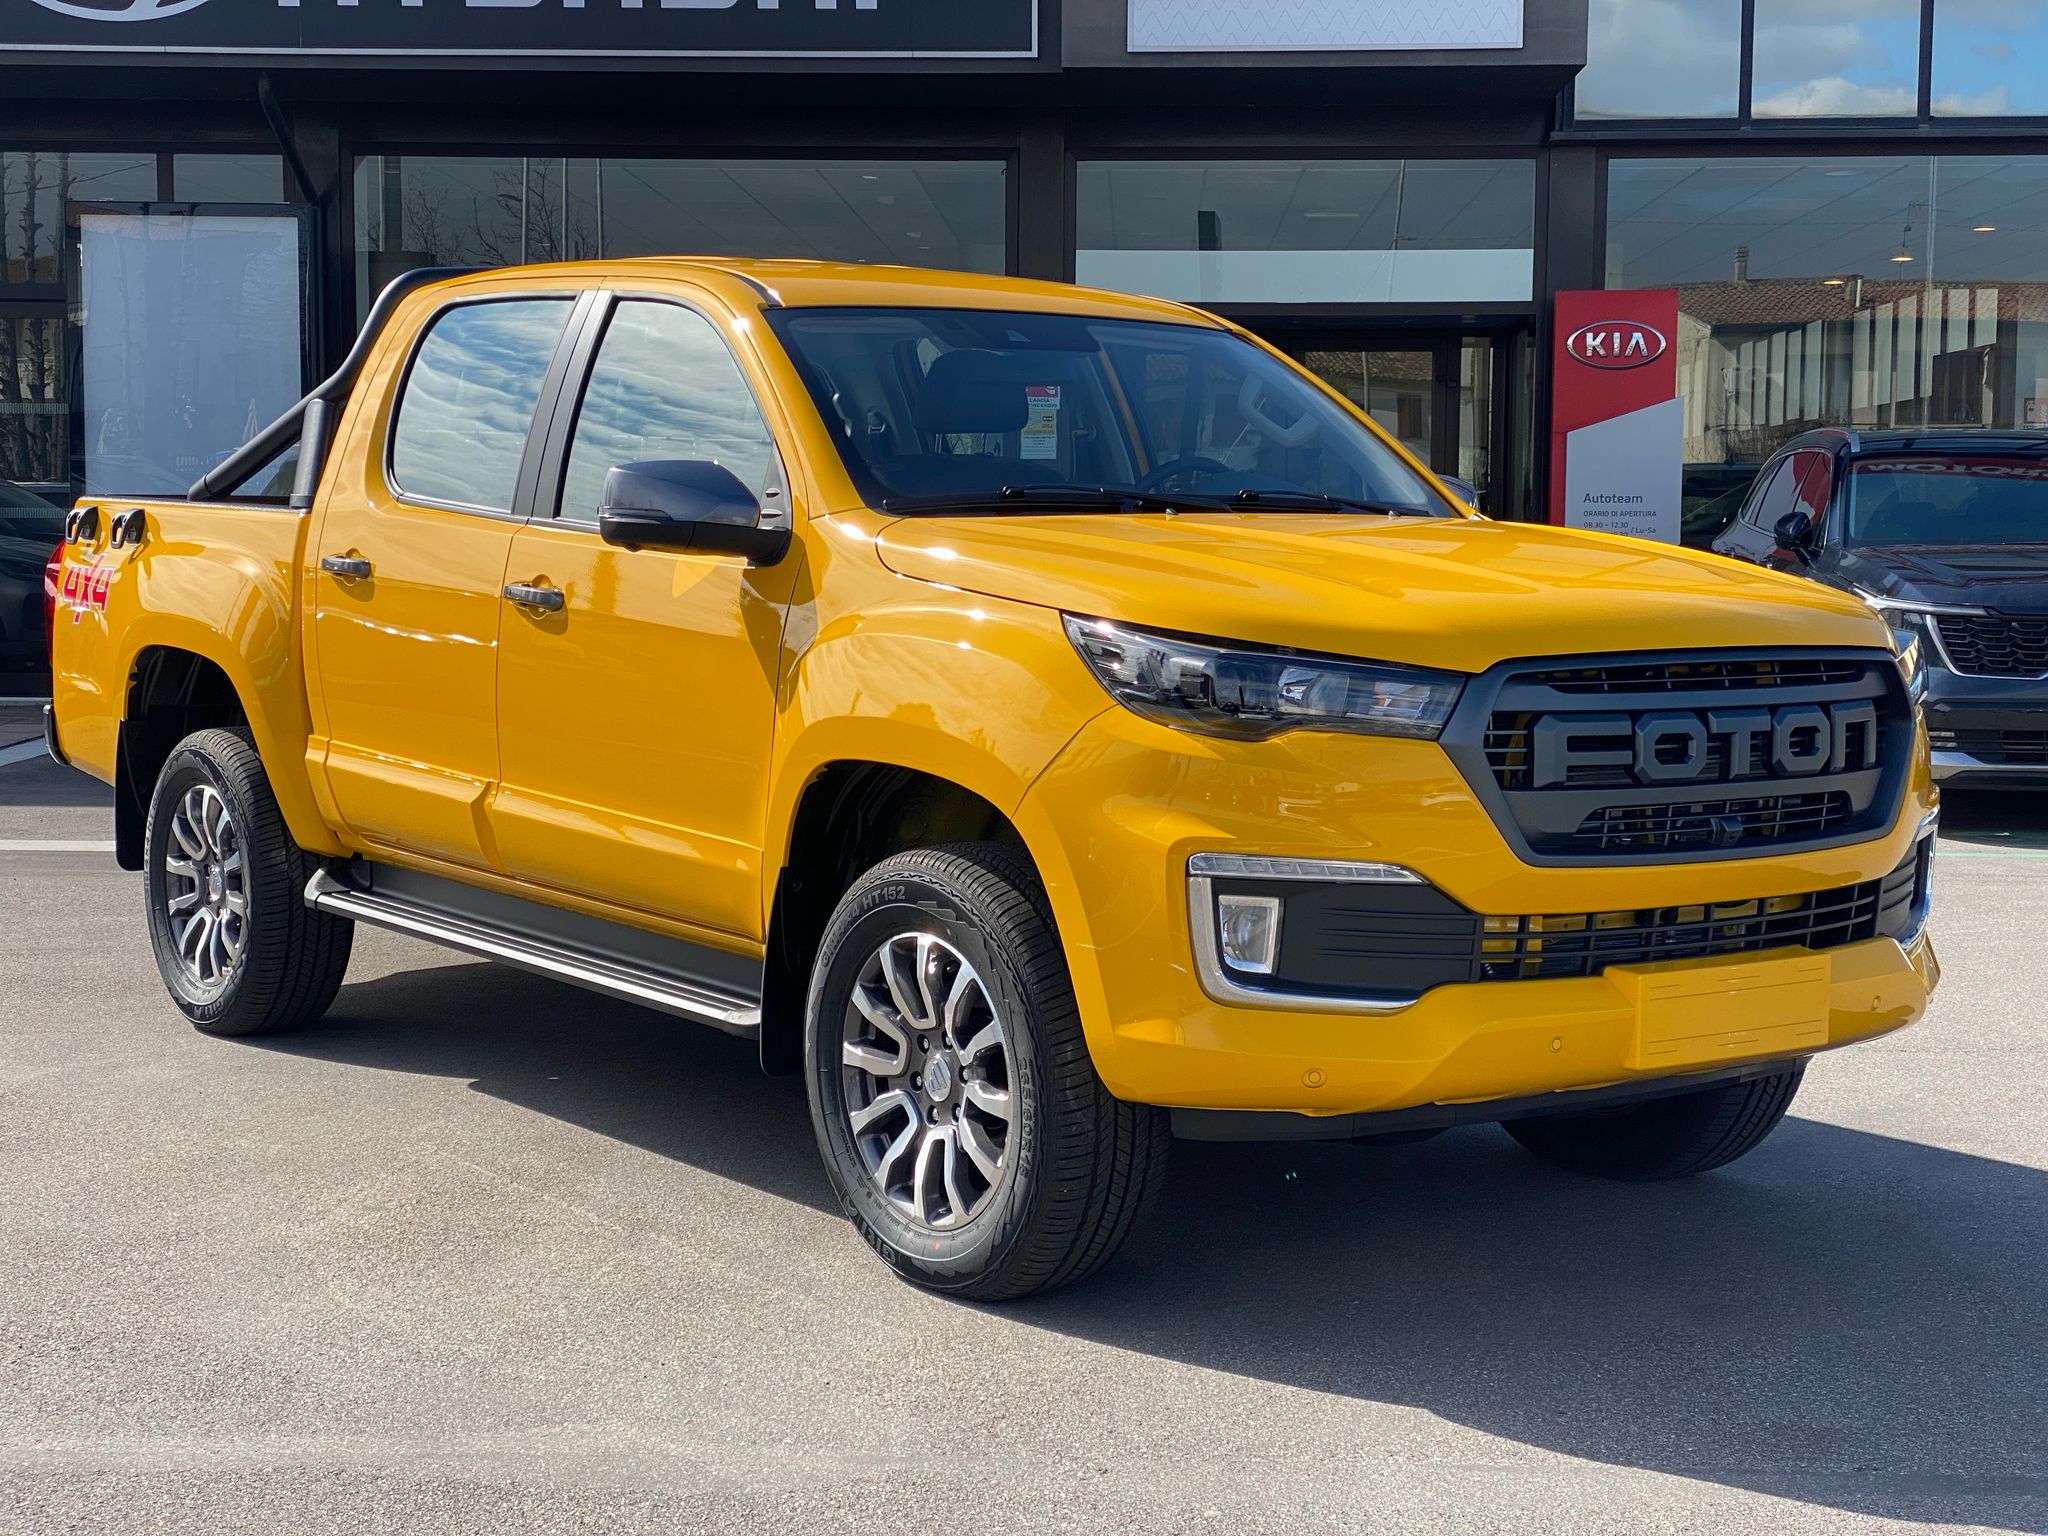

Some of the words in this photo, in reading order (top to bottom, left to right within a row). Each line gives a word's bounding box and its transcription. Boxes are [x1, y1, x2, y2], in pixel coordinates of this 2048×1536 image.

[1585, 332, 1649, 357] KIA
[1583, 493, 1643, 504] Autoteam
[1583, 510, 1609, 518] ORARIO
[1611, 510, 1618, 518] DI
[1619, 510, 1657, 518] APERTURA
[1583, 521, 1604, 529] 08.30
[1610, 521, 1629, 529] 12.30
[1635, 526, 1657, 534] Lu-Sa
[1533, 700, 1877, 788] FOTON
[862, 885, 906, 910] HT152
